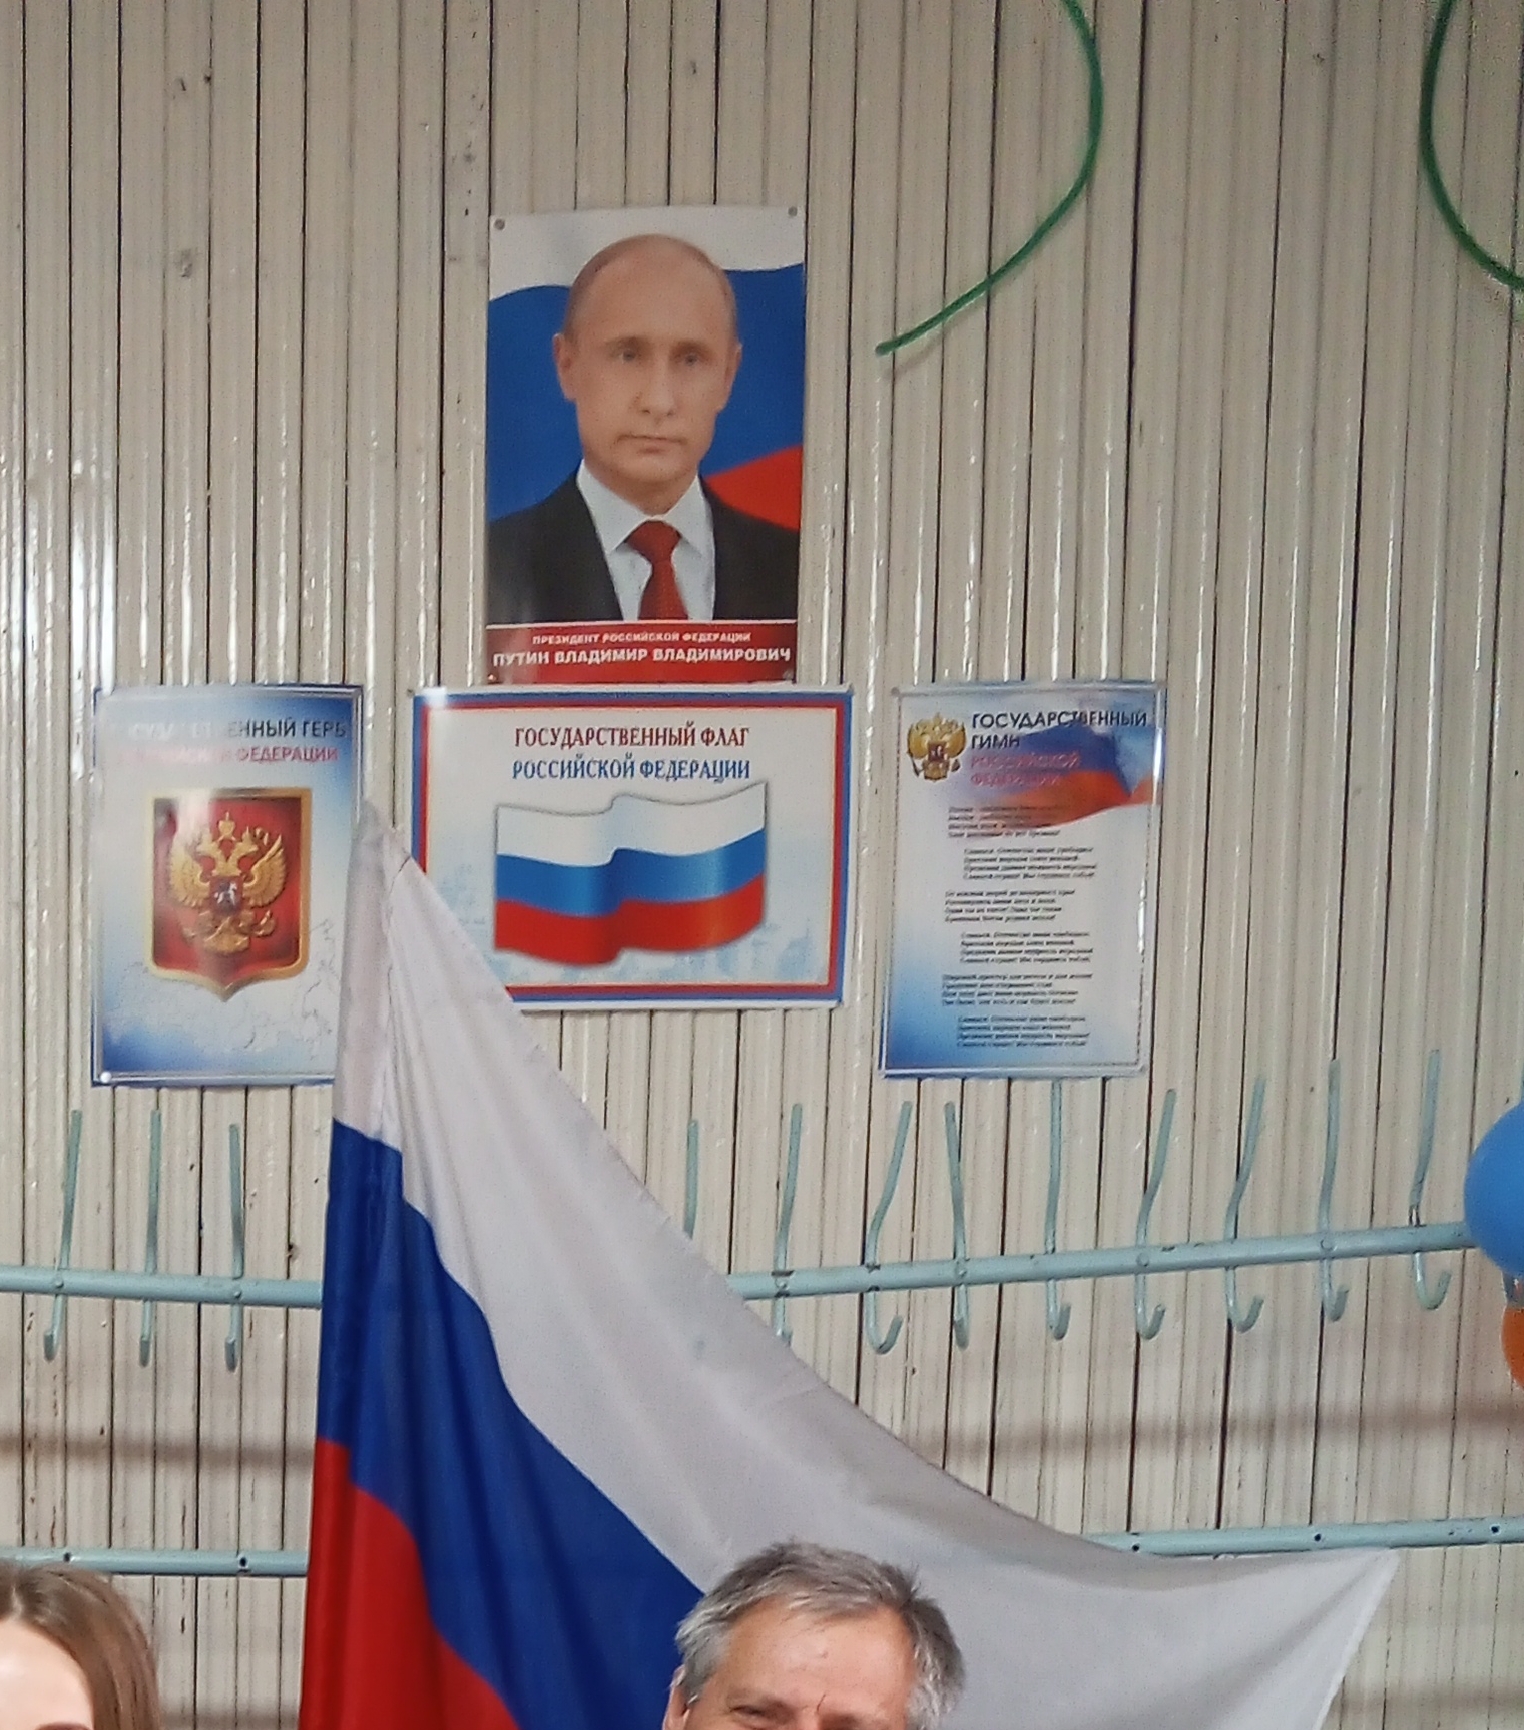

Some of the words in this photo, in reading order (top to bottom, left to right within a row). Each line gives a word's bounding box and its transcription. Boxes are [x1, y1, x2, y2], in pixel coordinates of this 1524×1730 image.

[532, 632, 600, 646] ПРЕЗИДЕНТ
[602, 630, 680, 644] РОССИЙСКОЙ
[682, 631, 751, 644] ФЕДЕРАЦИИ
[492, 650, 549, 667] ПУТИН
[554, 648, 648, 666] ВЛАДИМИР
[652, 647, 792, 664] ВЛАДИМИРОВИЧ
[302, 719, 347, 738] ГЕРБ
[971, 710, 1147, 729] ГОСУДАРСТВЕННЫЙ
[514, 721, 696, 750] ГОСУДАРСТВЕННЫЙ
[701, 726, 750, 748] ФЛАГ
[970, 733, 1021, 750] ГИМН
[512, 752, 636, 780] РОССИЙСКОЙ
[639, 758, 750, 784] ФЕДЕРАЦИИ
